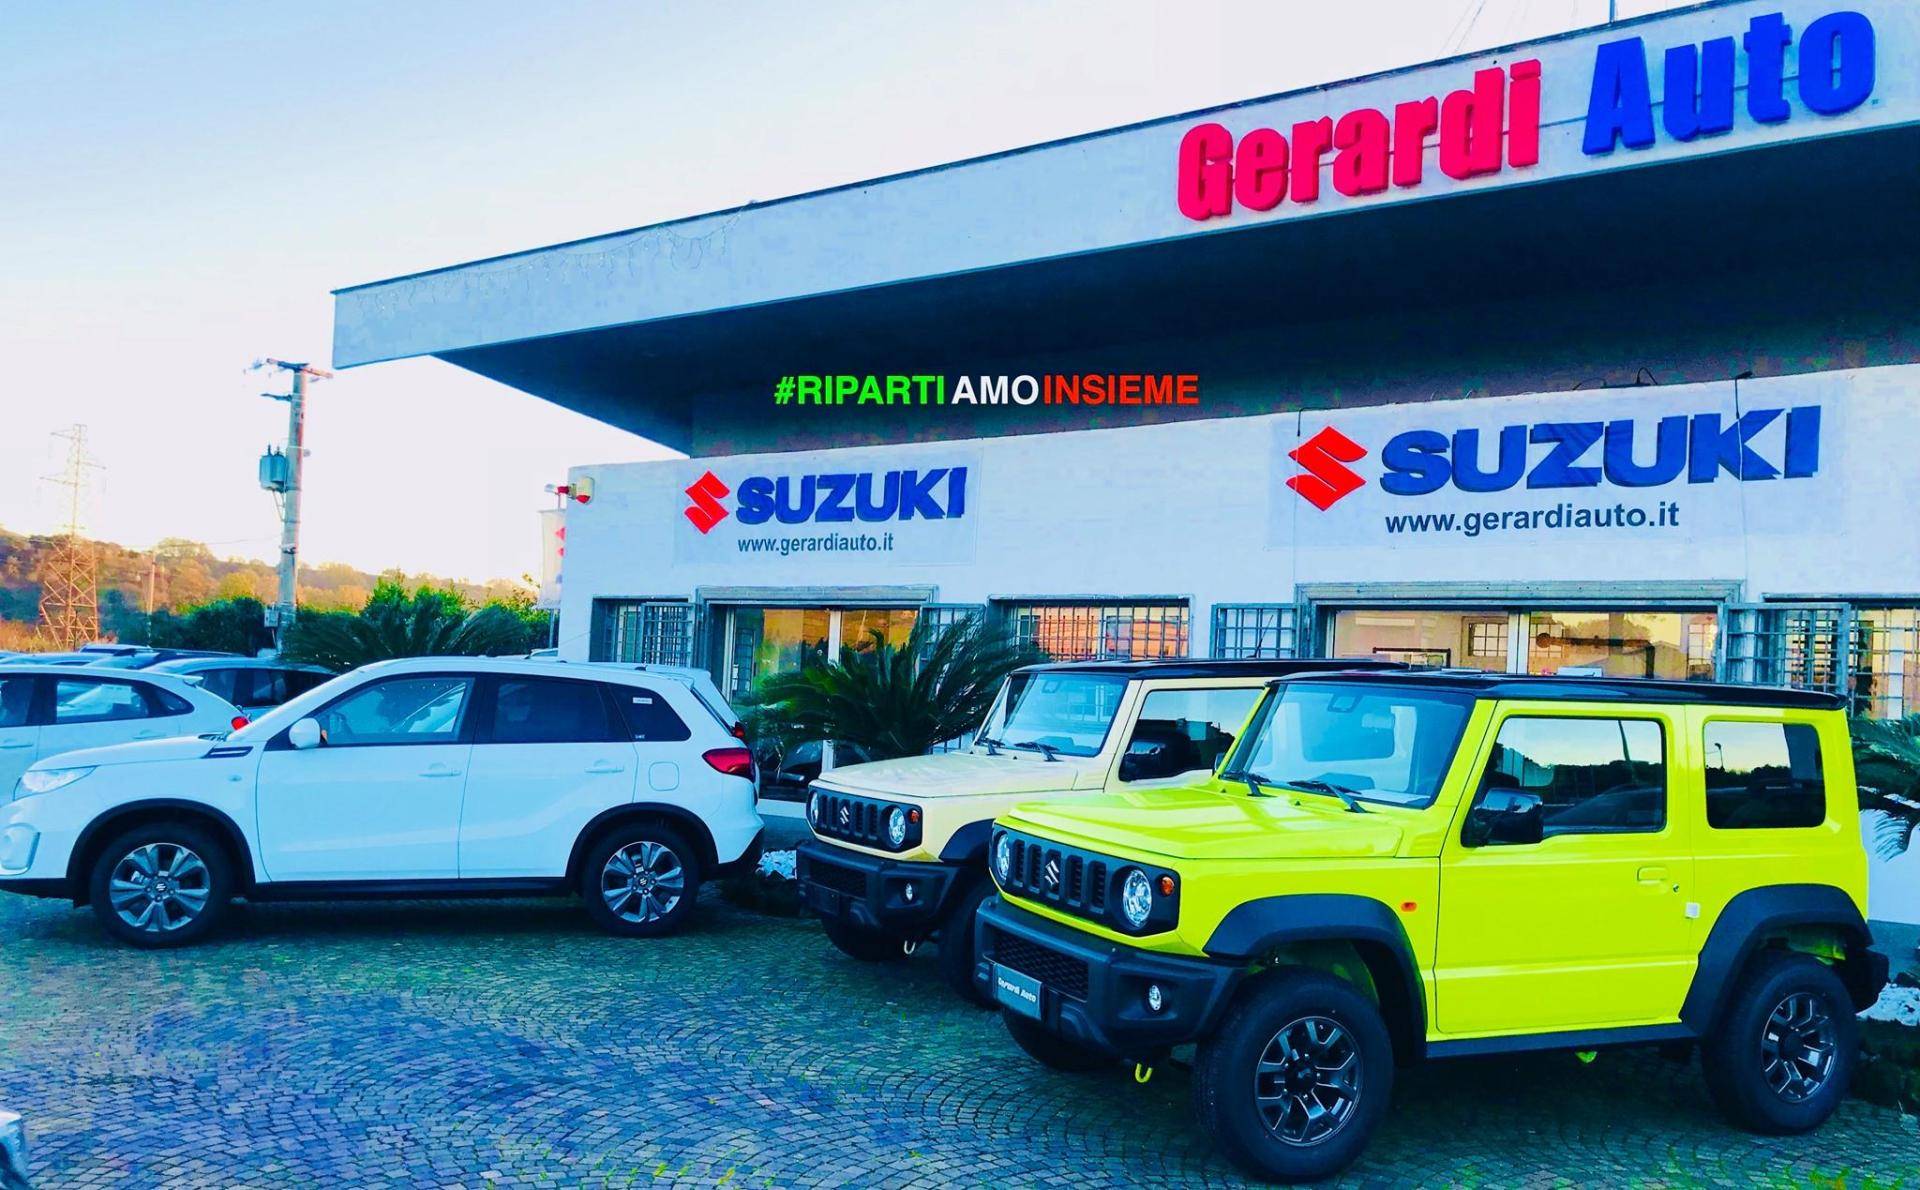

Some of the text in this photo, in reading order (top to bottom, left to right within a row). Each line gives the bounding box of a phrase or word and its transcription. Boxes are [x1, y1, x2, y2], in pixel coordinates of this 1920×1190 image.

[1177, 10, 1876, 222] Gerardi Auto
[1379, 404, 1823, 496] SUZUKI
[735, 466, 968, 525] SUZUKI
[1384, 500, 1681, 537] www.gerardiauto.it
[737, 532, 894, 556] www.gerardiauto.it
